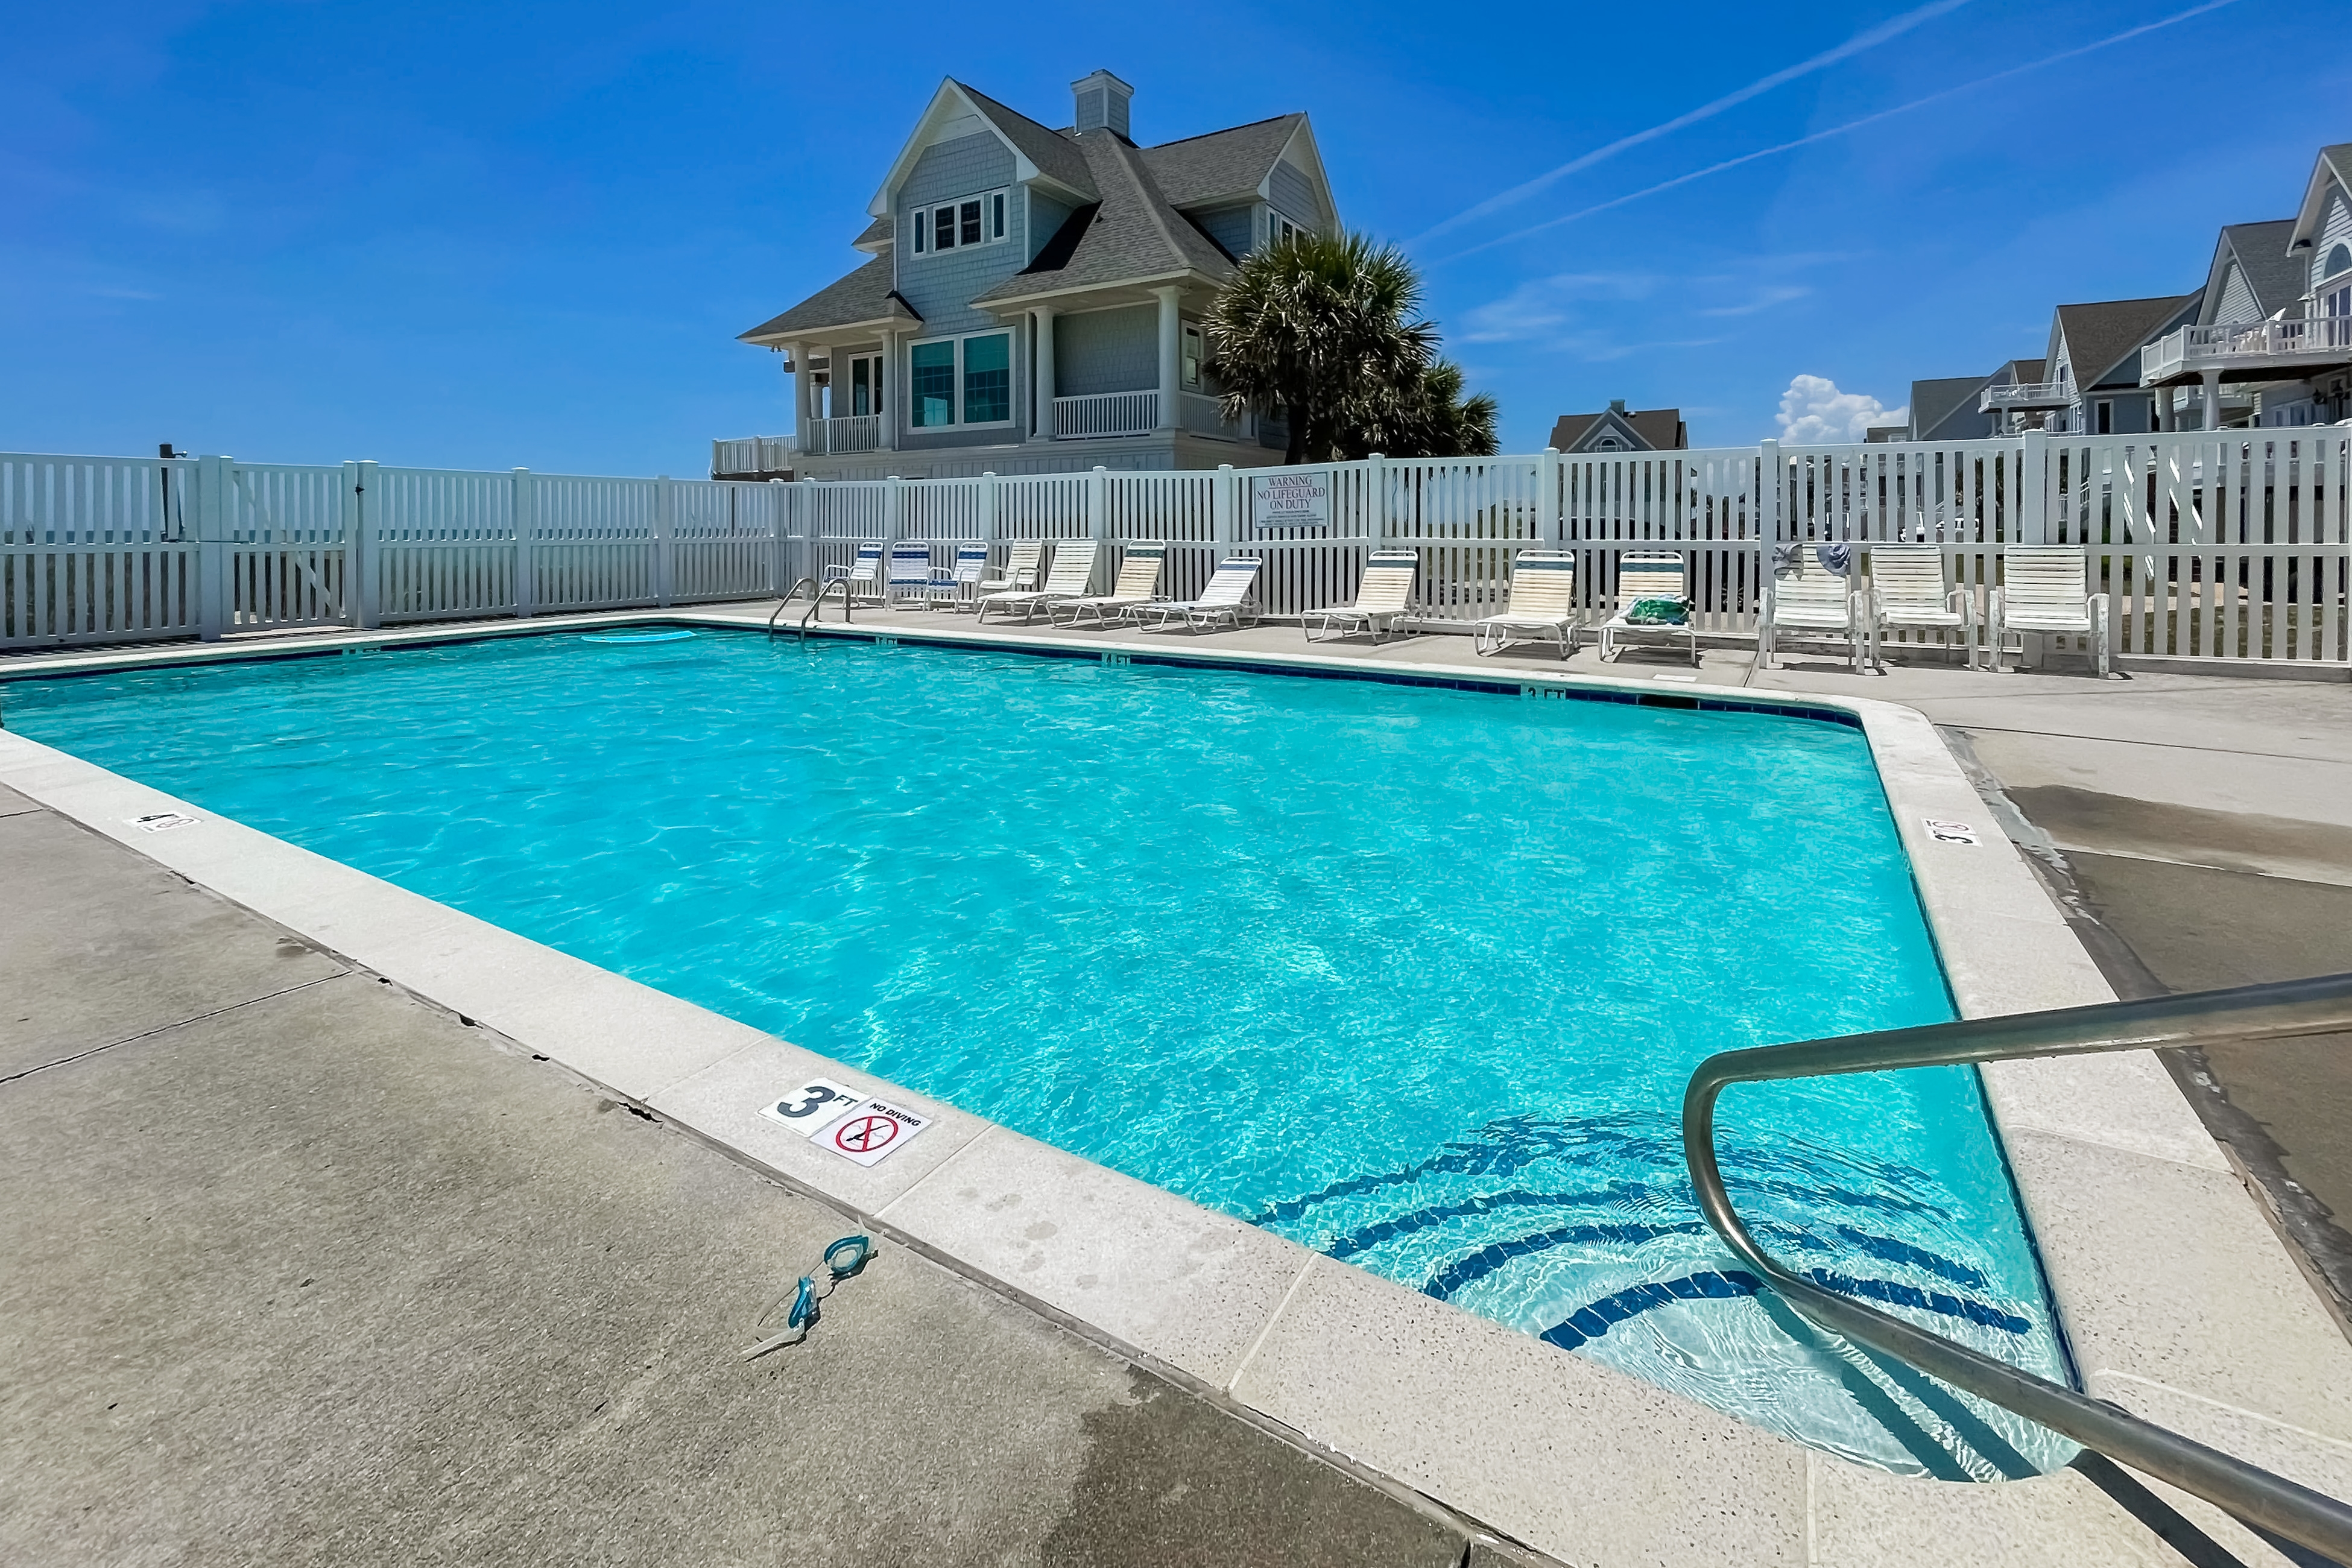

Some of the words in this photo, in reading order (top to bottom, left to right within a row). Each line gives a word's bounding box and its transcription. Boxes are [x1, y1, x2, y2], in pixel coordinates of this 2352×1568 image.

[1268, 475, 1312, 487] WARNING
[1257, 490, 1270, 500] NO
[1272, 487, 1326, 499] LIFEGUARD
[1270, 499, 1283, 510] ON
[1286, 499, 1311, 509] DUTY
[777, 1086, 836, 1118] 3
[832, 1094, 859, 1107] FT
[870, 1103, 887, 1112] NO
[885, 1109, 922, 1126] DIVING
